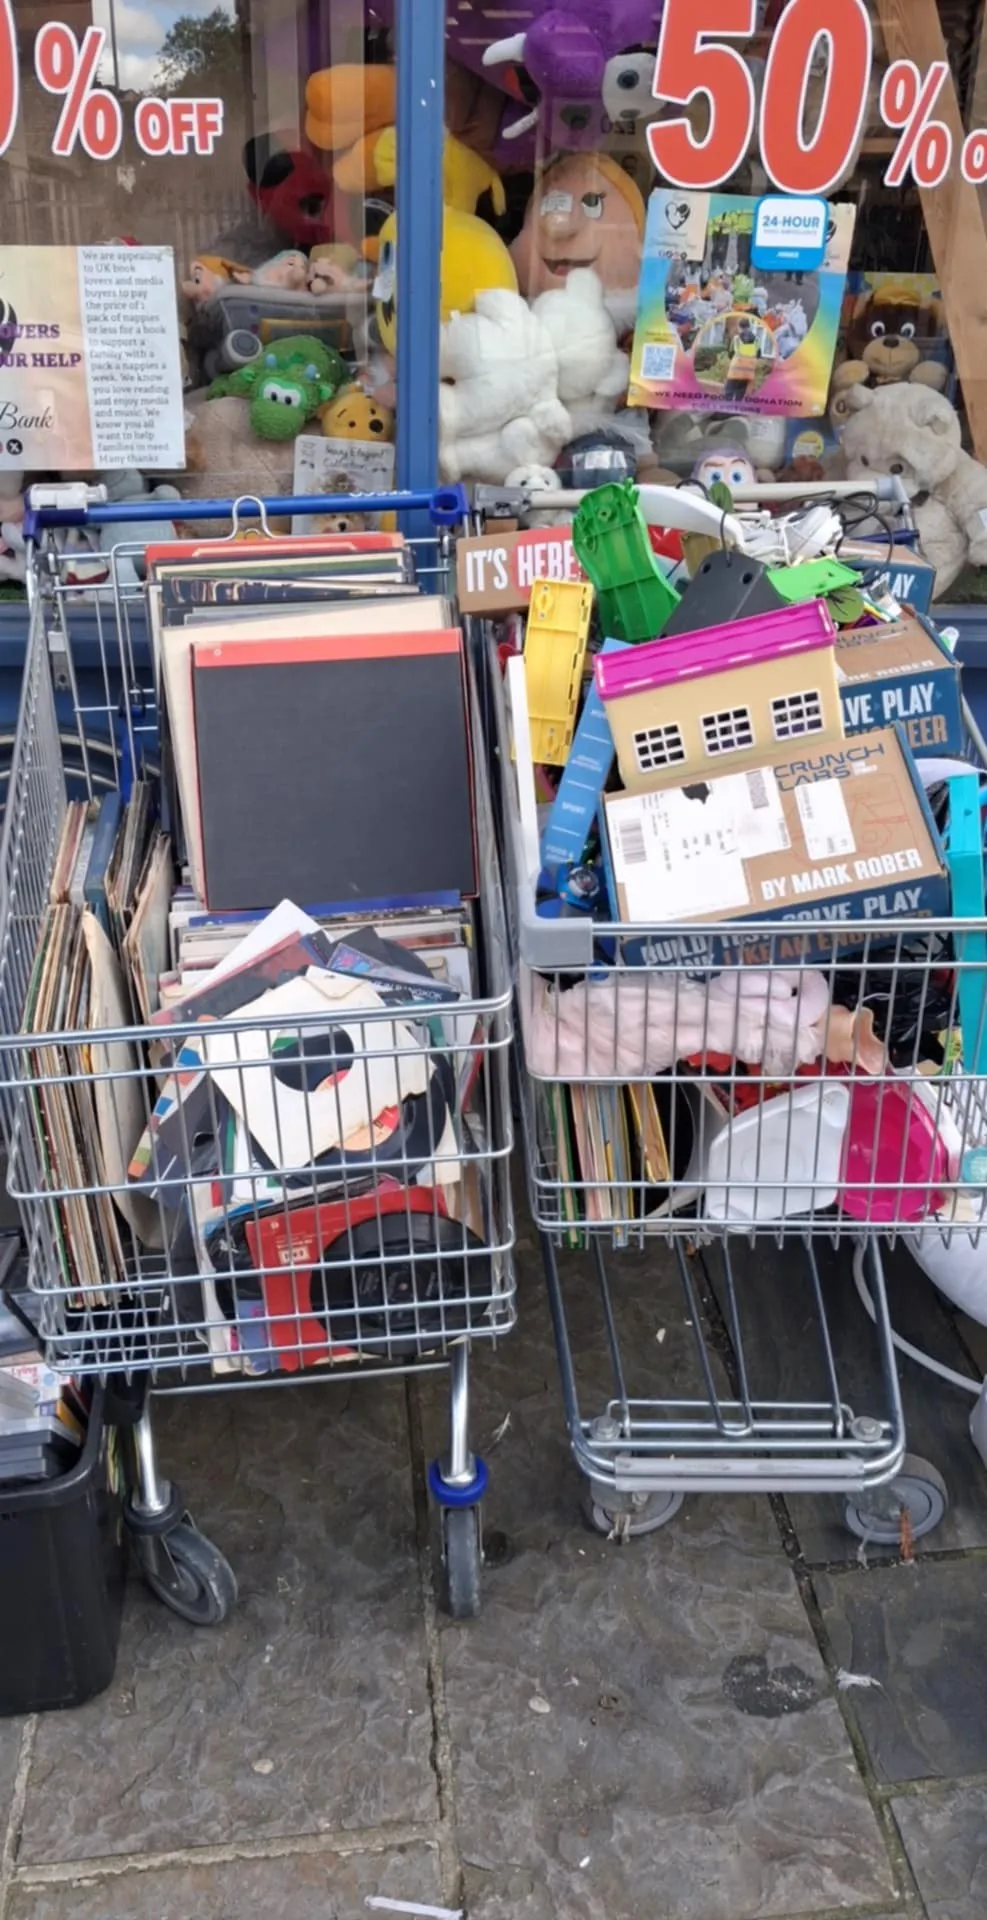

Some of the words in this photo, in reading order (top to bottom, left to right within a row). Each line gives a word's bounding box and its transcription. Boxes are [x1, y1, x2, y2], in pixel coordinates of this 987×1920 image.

[135, 98, 223, 155] OFF
[95, 263, 111, 273] UK
[112, 264, 136, 273] book
[115, 277, 132, 285] and
[103, 302, 127, 311] price
[129, 301, 139, 310] of
[130, 290, 148, 300] pay
[111, 313, 121, 321] of
[31, 352, 81, 368] HELP
[0, 402, 53, 430] Bank
[466, 547, 509, 593] IT'S
[518, 540, 581, 588] HERE
[881, 682, 934, 721] PLAY
[774, 743, 885, 779] CRUNCH
[777, 765, 851, 792] LABS
[761, 876, 787, 900] BY
[791, 863, 853, 895] MARK
[854, 848, 924, 881] ROBER
[640, 935, 708, 965] BUILD
[863, 887, 922, 919] PLAY
